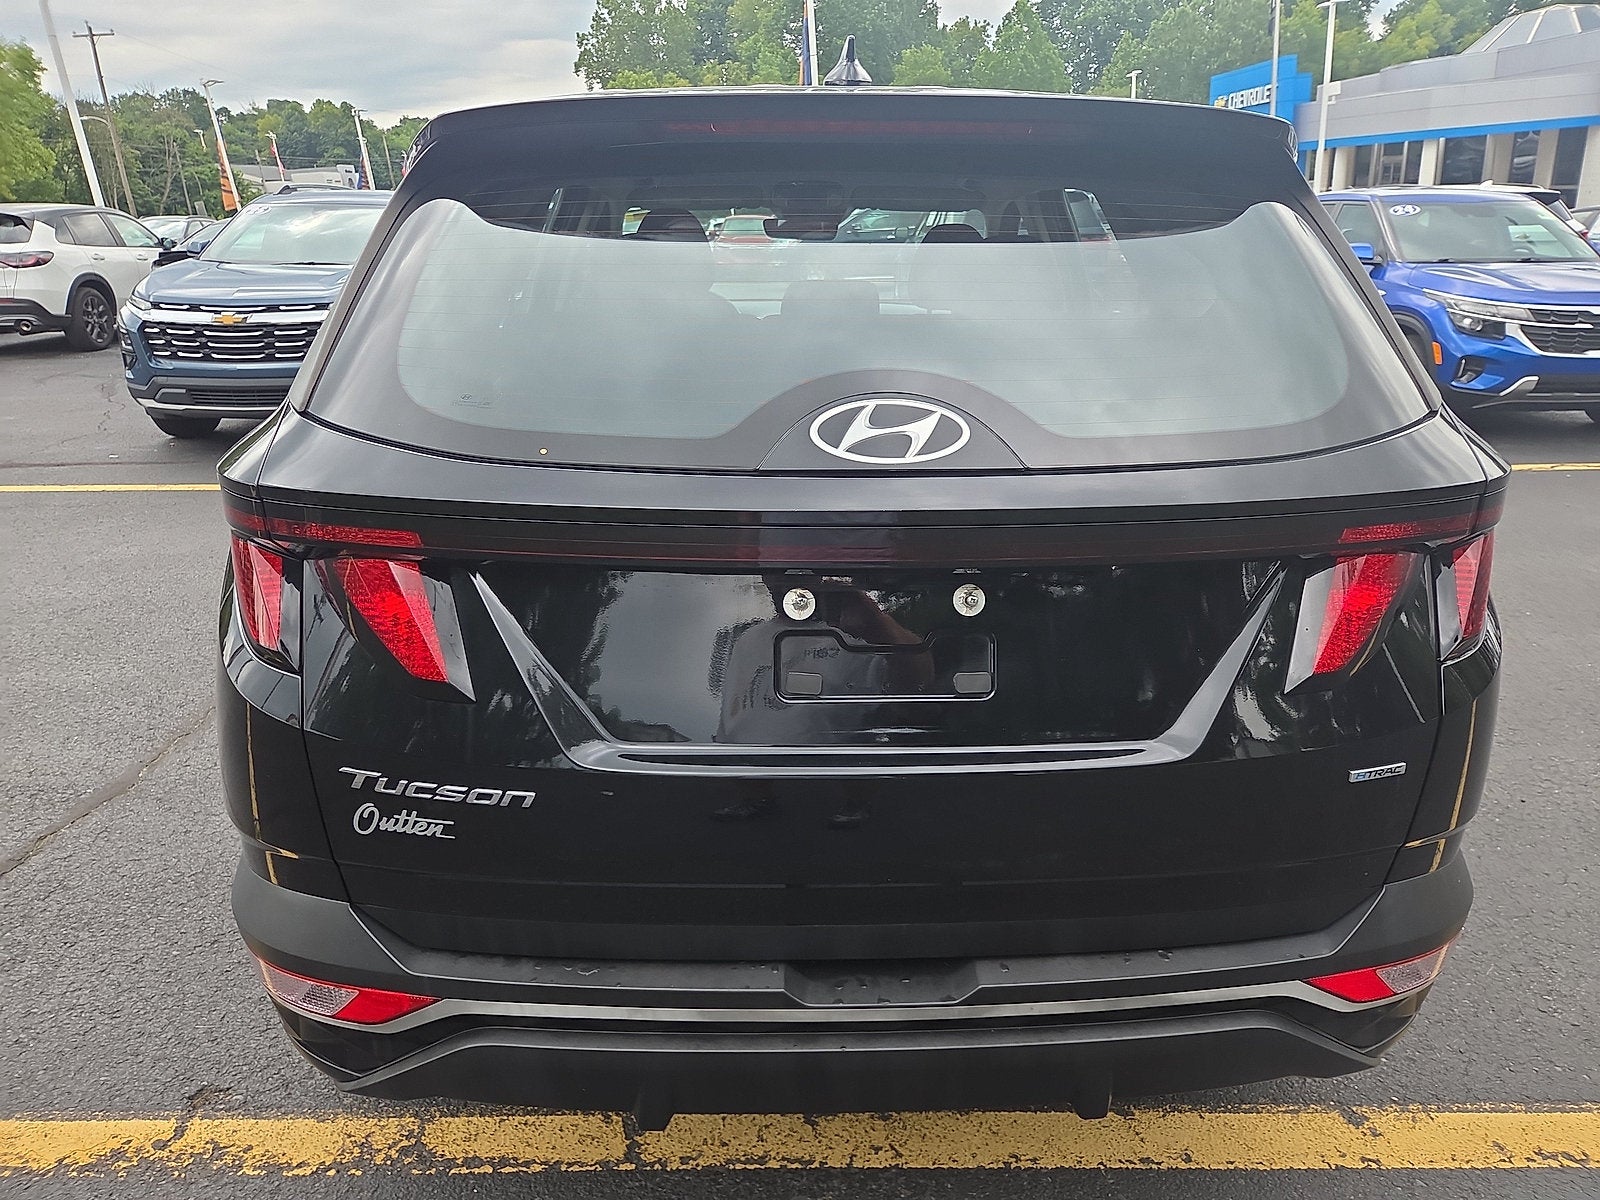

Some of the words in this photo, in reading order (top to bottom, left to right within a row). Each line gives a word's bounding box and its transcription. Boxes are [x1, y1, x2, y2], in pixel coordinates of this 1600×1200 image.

[1228, 84, 1278, 109] CHEVROLE
[1352, 764, 1405, 782] HTRAC
[352, 802, 456, 840] Outten
